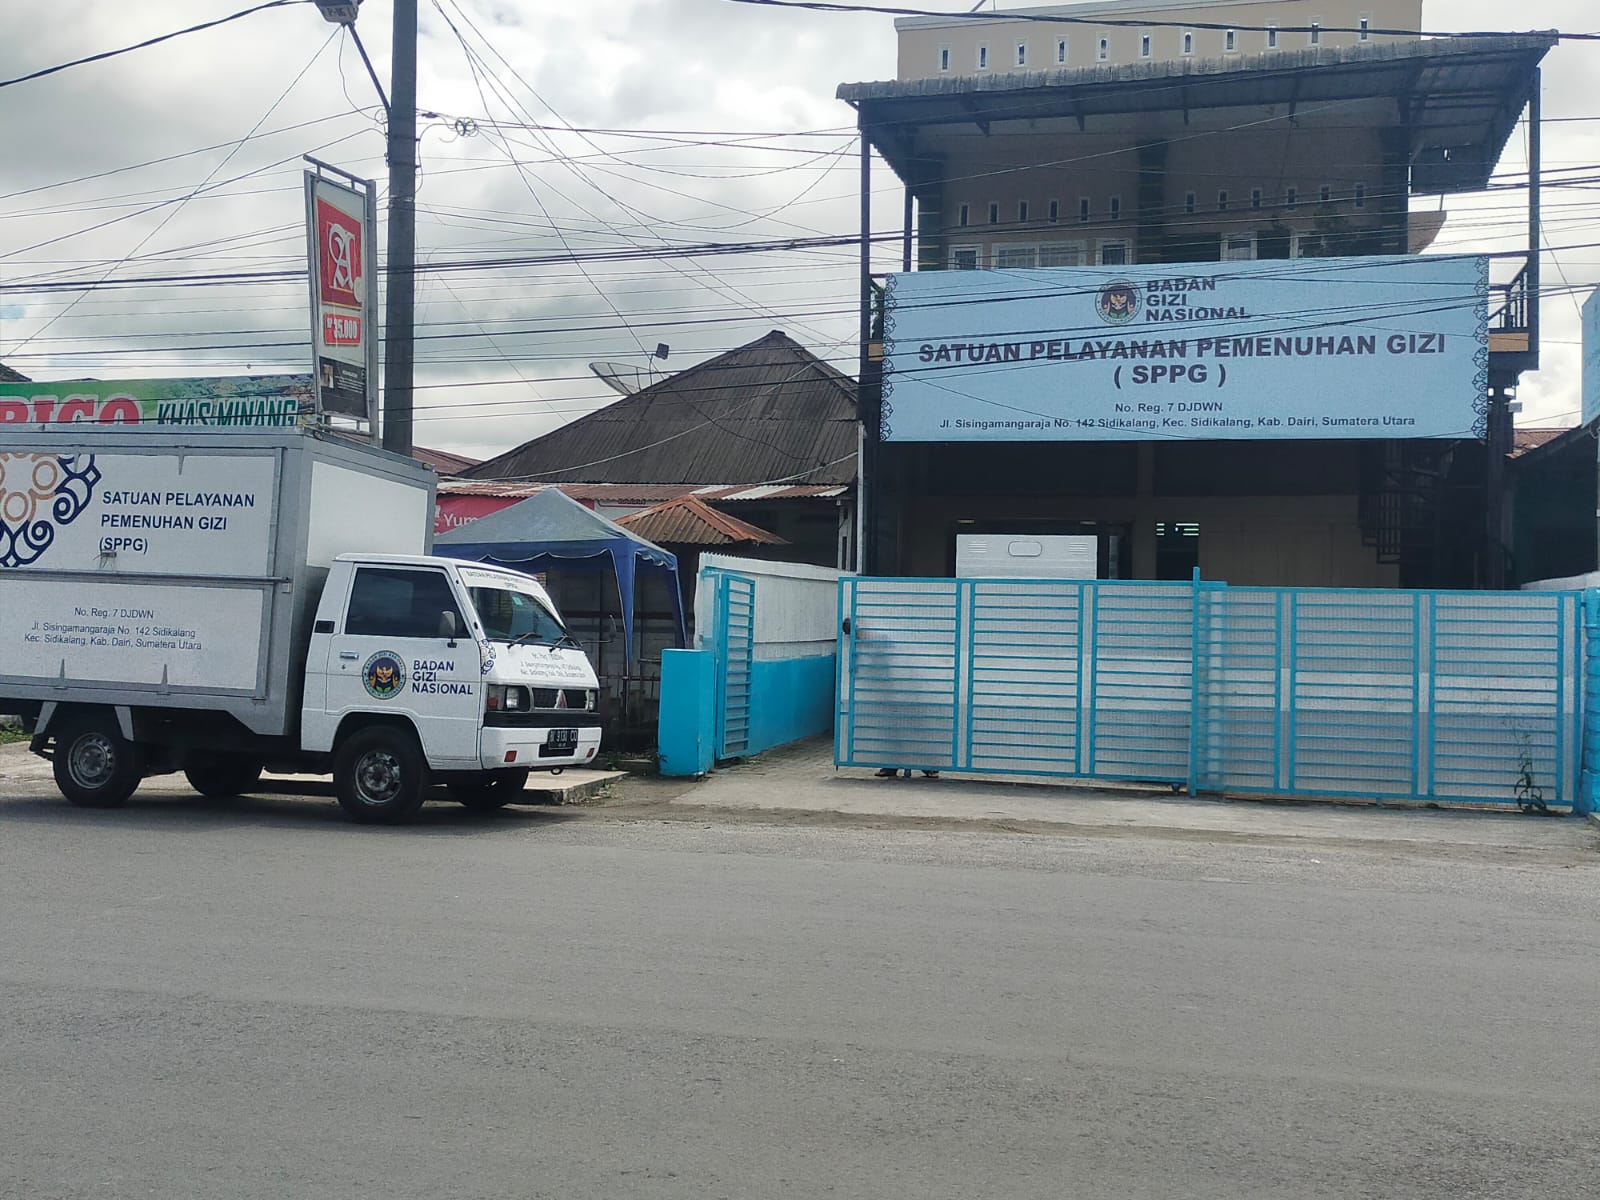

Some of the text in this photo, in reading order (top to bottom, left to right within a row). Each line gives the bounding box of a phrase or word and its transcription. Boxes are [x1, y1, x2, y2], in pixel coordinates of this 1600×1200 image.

[1146, 278, 1216, 292] BADAN
[1146, 294, 1187, 306] GIZI
[1146, 307, 1248, 322] NASIONAL
[918, 333, 1446, 363] SATUAN PELAYANAN PEMENUHAN GIZI
[1132, 364, 1208, 384] SPPG
[217, 399, 298, 427] MINANG
[1115, 402, 1223, 414] No. Reg. 7 DJDWN
[940, 416, 1415, 431] Jl. Sisingamangaraja No. 142 Sidikalang, Kec. Sidikalang, Kab. Dairi, Sumatera Utara
[102, 491, 255, 507] SATUAN PELAYANAN
[101, 514, 227, 530] PEMENUHAN GIZI
[99, 537, 148, 554] (SPPG)
[74, 608, 154, 619] No. Reg. 7 DJDWN
[43, 623, 115, 636] Sisingamangaraja
[135, 627, 150, 636] 142
[152, 627, 196, 638] Sidikalang
[91, 636, 109, 646] Kab.
[135, 639, 176, 649] Sumatera
[178, 640, 202, 650] Utara
[413, 660, 455, 671] BADAN
[412, 671, 437, 682] GIZI
[411, 683, 474, 695] NASIONAL
